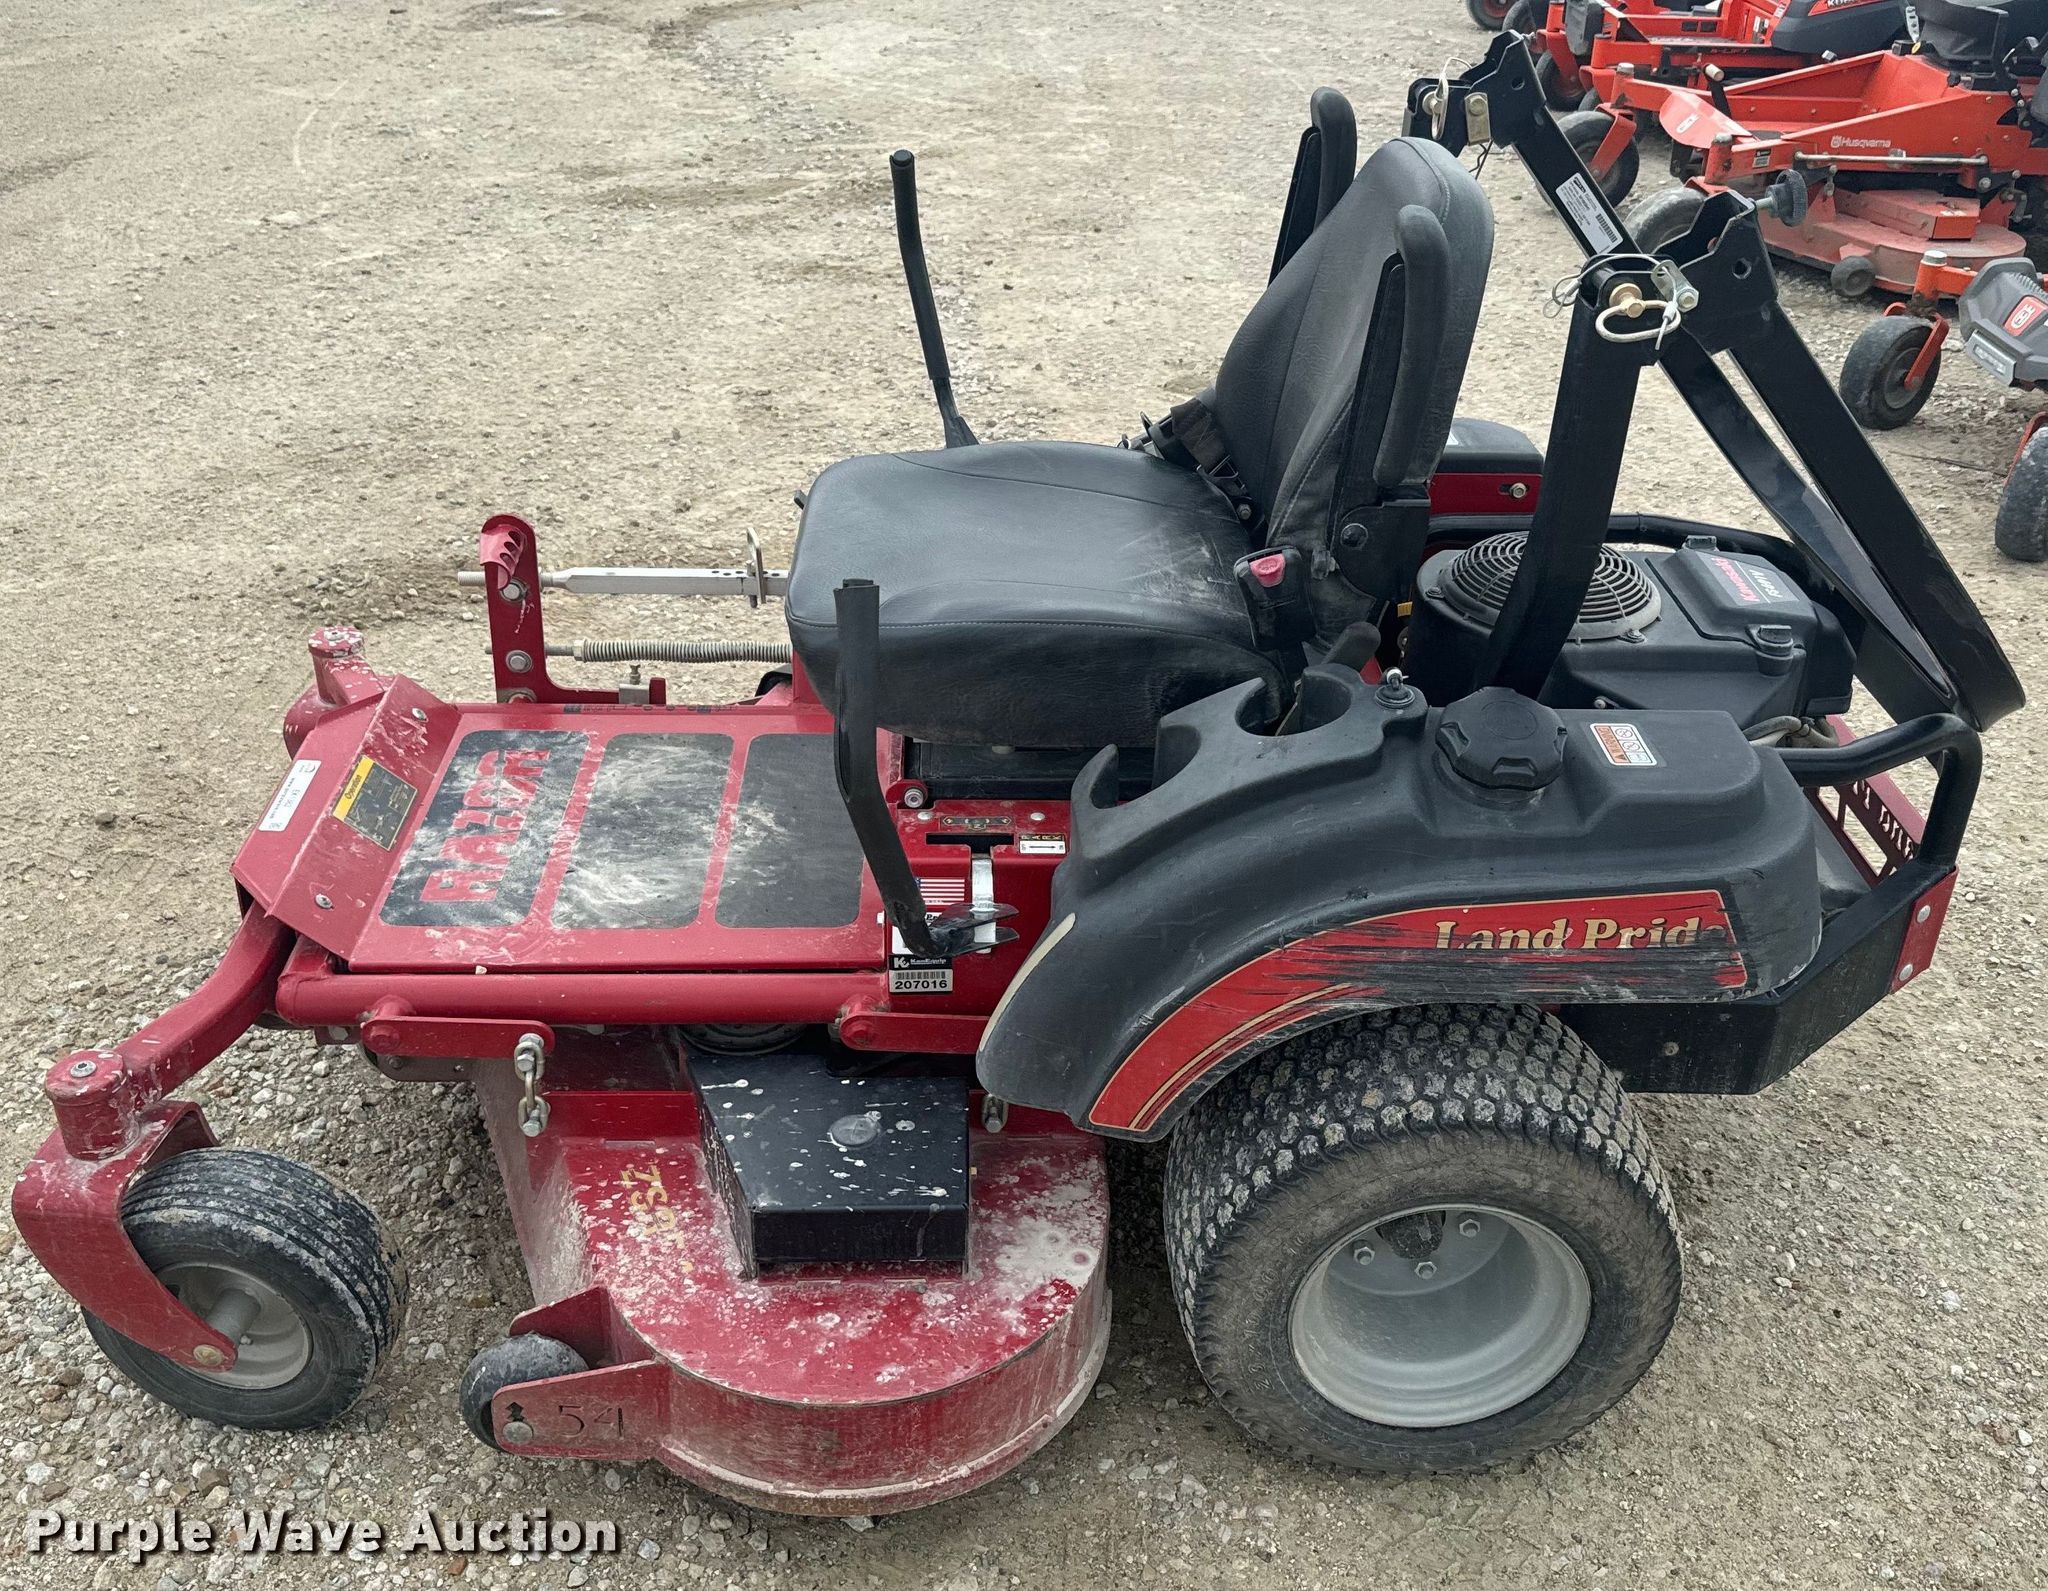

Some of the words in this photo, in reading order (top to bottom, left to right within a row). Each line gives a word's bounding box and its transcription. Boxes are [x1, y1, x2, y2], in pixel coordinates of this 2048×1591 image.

[1841, 137, 1891, 149] Husqvarna
[345, 775, 362, 799] Operation
[420, 750, 550, 902] RAZOR
[1435, 918, 1567, 949] Land
[895, 980, 947, 989] 207016
[559, 1404, 624, 1438] 54
